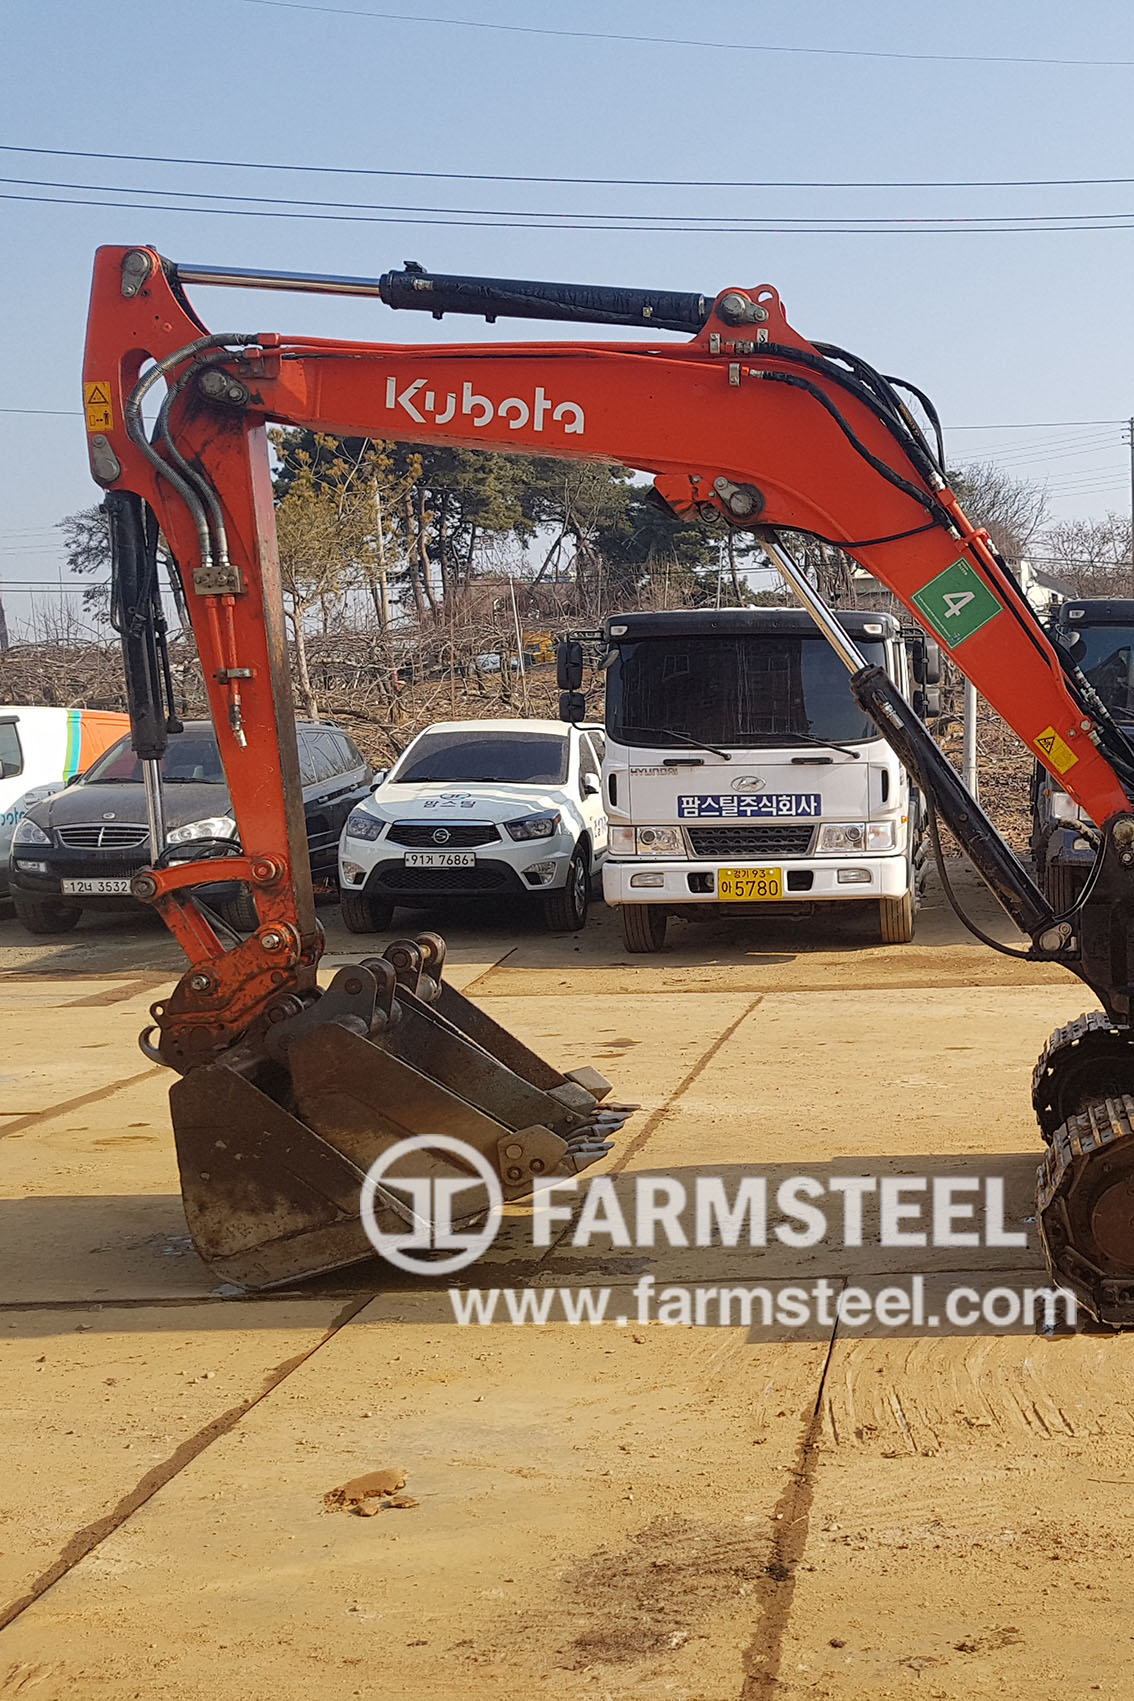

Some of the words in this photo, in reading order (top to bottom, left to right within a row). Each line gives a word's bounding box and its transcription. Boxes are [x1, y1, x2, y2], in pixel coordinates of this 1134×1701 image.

[386, 376, 585, 434] Kubota
[942, 591, 976, 619] 4
[681, 794, 818, 817] 팜스틸주식회사
[411, 854, 434, 865] 91거
[438, 854, 470, 866] 7686
[733, 869, 750, 879] 경기
[751, 869, 767, 879] 93
[97, 881, 129, 893] 3532
[721, 881, 732, 894] 아
[735, 880, 779, 897] 5780
